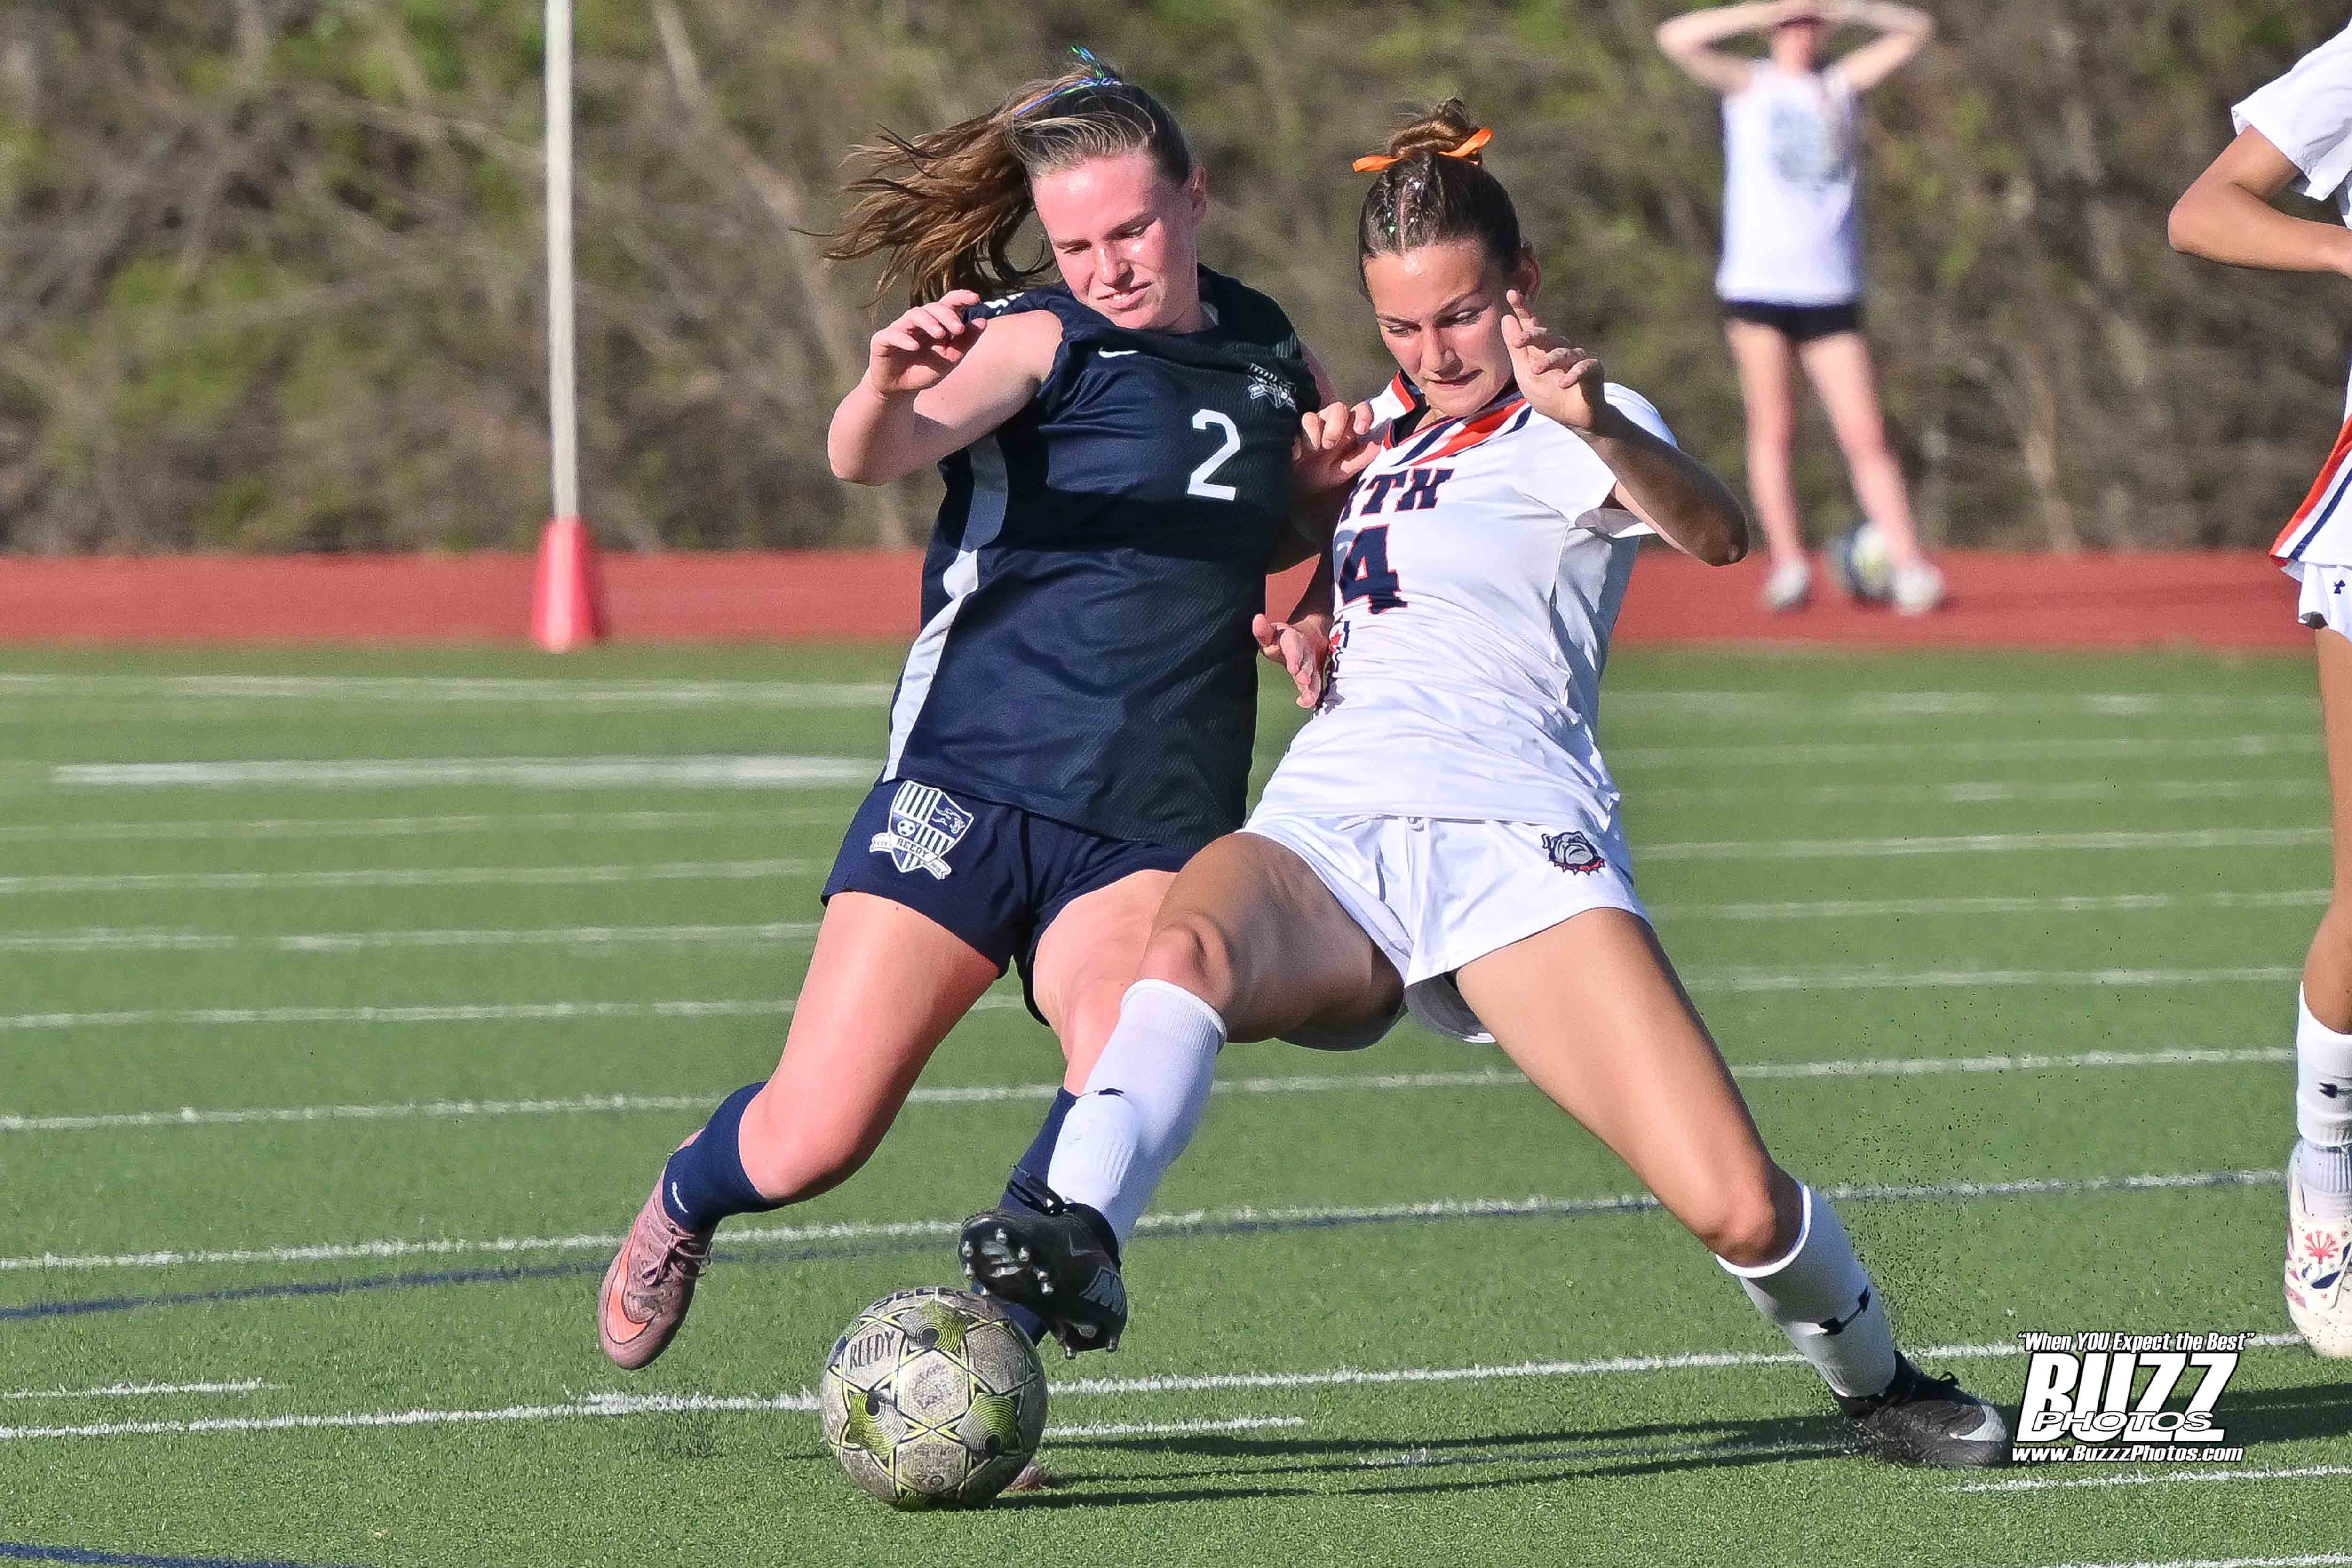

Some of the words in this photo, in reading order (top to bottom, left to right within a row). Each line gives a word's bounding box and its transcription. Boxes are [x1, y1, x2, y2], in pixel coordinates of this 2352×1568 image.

[1187, 409, 1241, 501] 2
[897, 838, 930, 858] REEDY
[850, 1330, 896, 1371] REEDY
